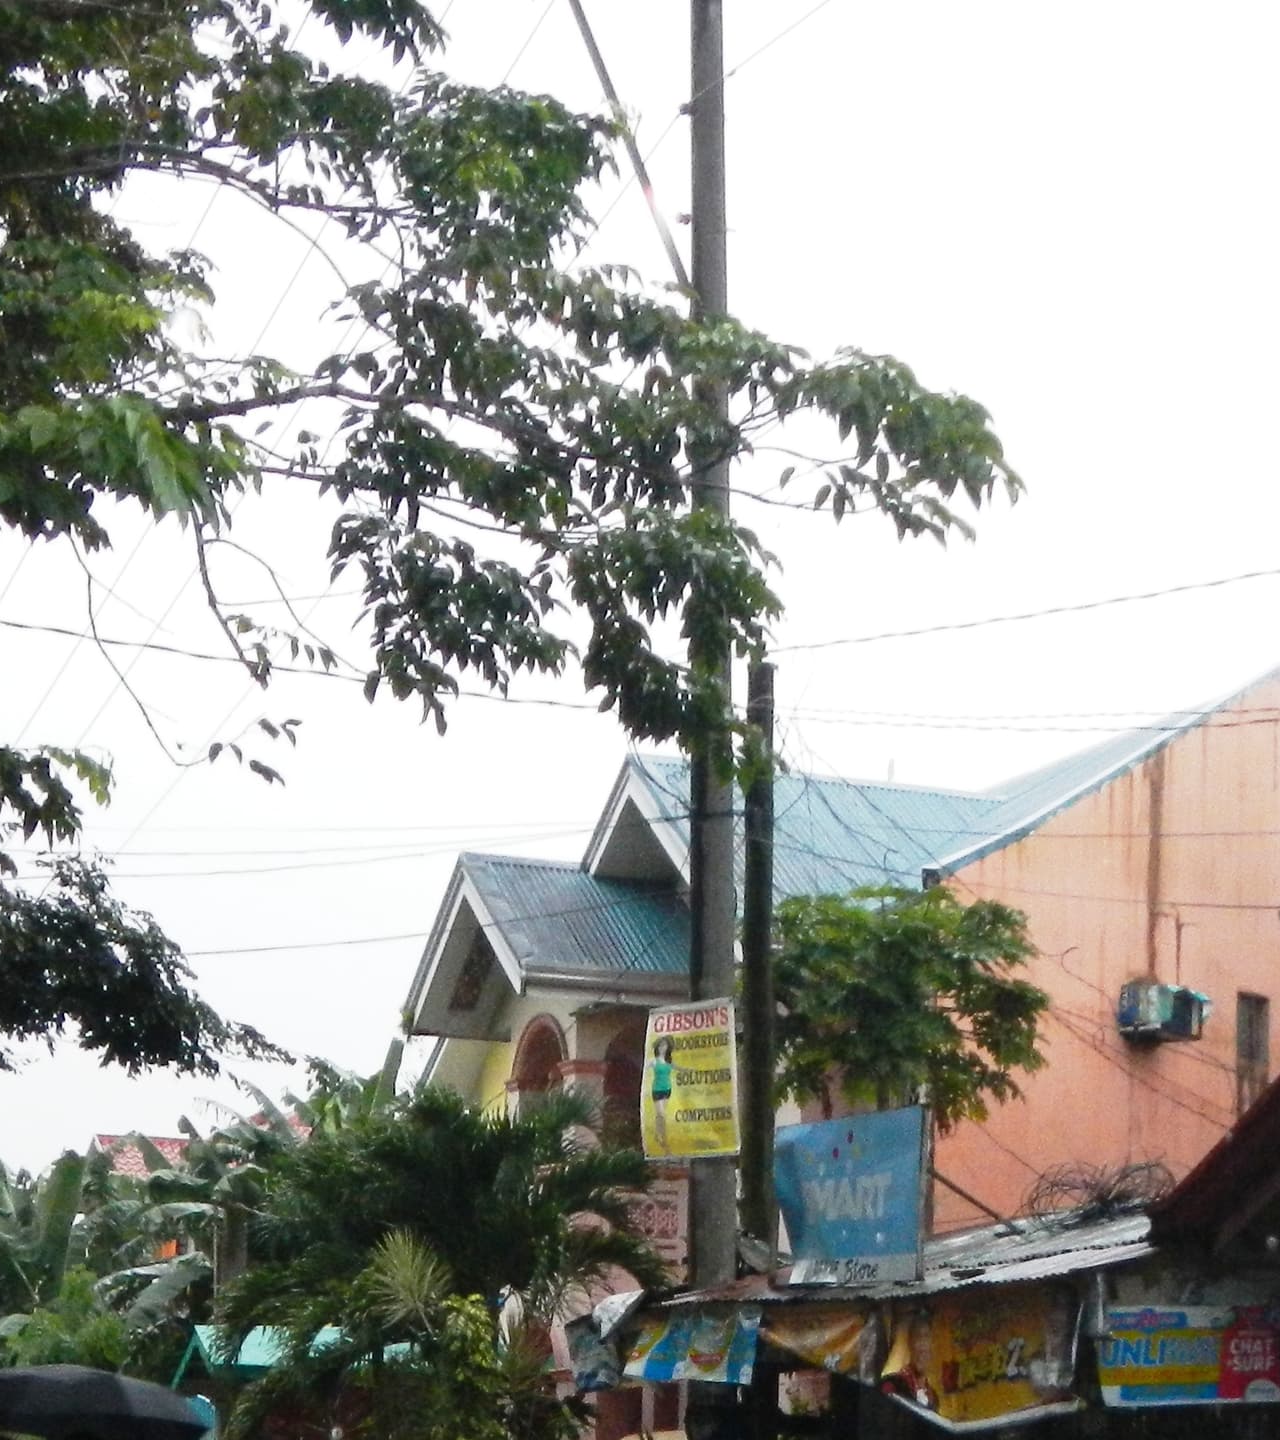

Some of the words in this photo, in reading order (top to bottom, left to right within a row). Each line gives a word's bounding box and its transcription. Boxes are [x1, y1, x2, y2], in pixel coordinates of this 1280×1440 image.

[654, 1007, 729, 1033] GIBSON'S
[674, 1031, 729, 1050] BOOKSTORE
[676, 1068, 732, 1086] SOLUTIONS
[675, 1106, 732, 1122] COMPUTERS
[1229, 1337, 1274, 1355] CHAT
